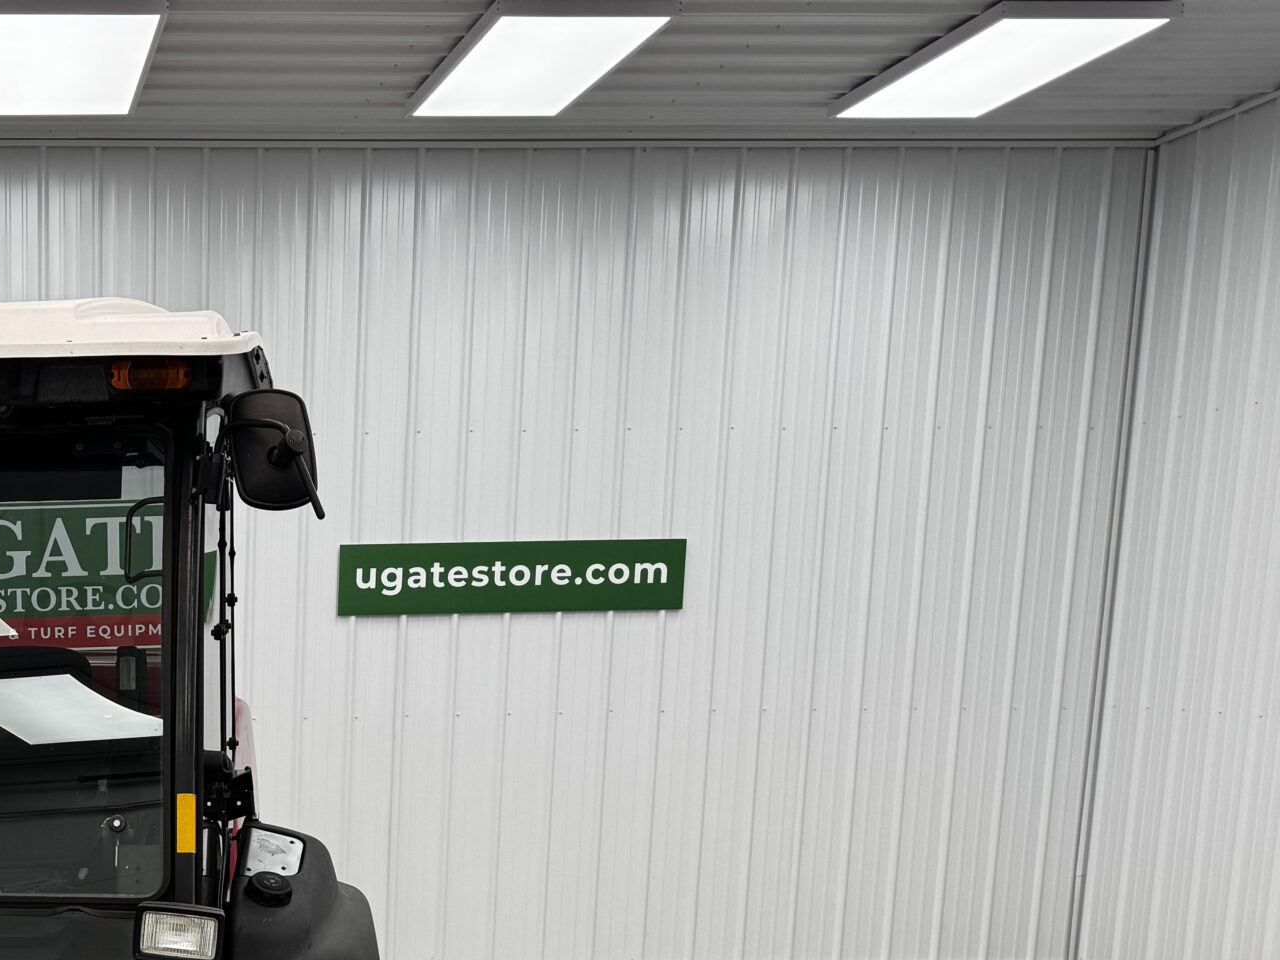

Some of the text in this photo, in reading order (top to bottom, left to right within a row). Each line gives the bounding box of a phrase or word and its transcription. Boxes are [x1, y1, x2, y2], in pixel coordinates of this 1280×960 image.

[355, 561, 669, 596] ugatestore.com
[28, 627, 77, 640] TURF
[86, 623, 162, 640] EQUIPM
